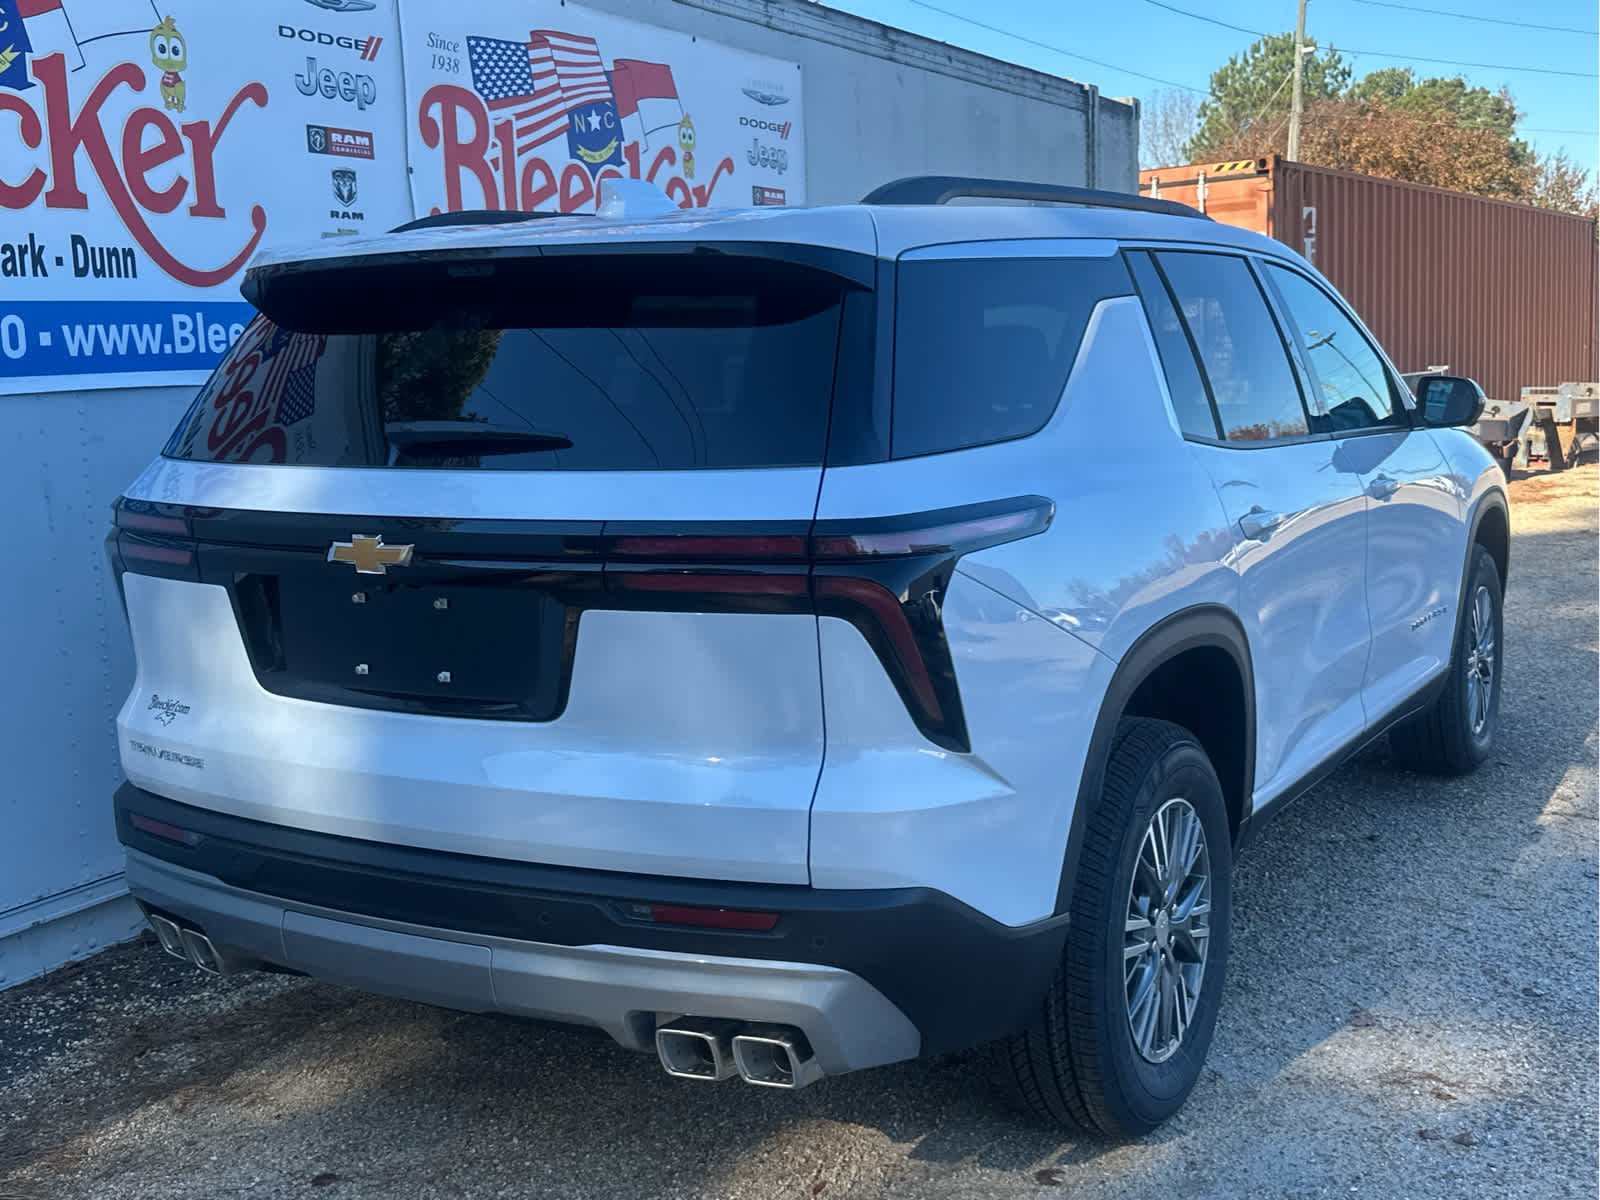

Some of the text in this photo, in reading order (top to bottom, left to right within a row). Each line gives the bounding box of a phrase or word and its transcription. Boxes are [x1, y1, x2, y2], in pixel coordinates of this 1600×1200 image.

[278, 25, 370, 52] DODGE
[426, 31, 460, 53] Since
[431, 54, 460, 73] 1938
[294, 56, 377, 111] Jeep
[573, 111, 616, 133] N C
[738, 116, 785, 133] DODGE
[330, 133, 370, 147] RAM
[418, 84, 735, 213] Bleer
[746, 138, 789, 176] Jeep
[330, 210, 364, 221] RAM
[0, 233, 138, 279] ark Dunn
